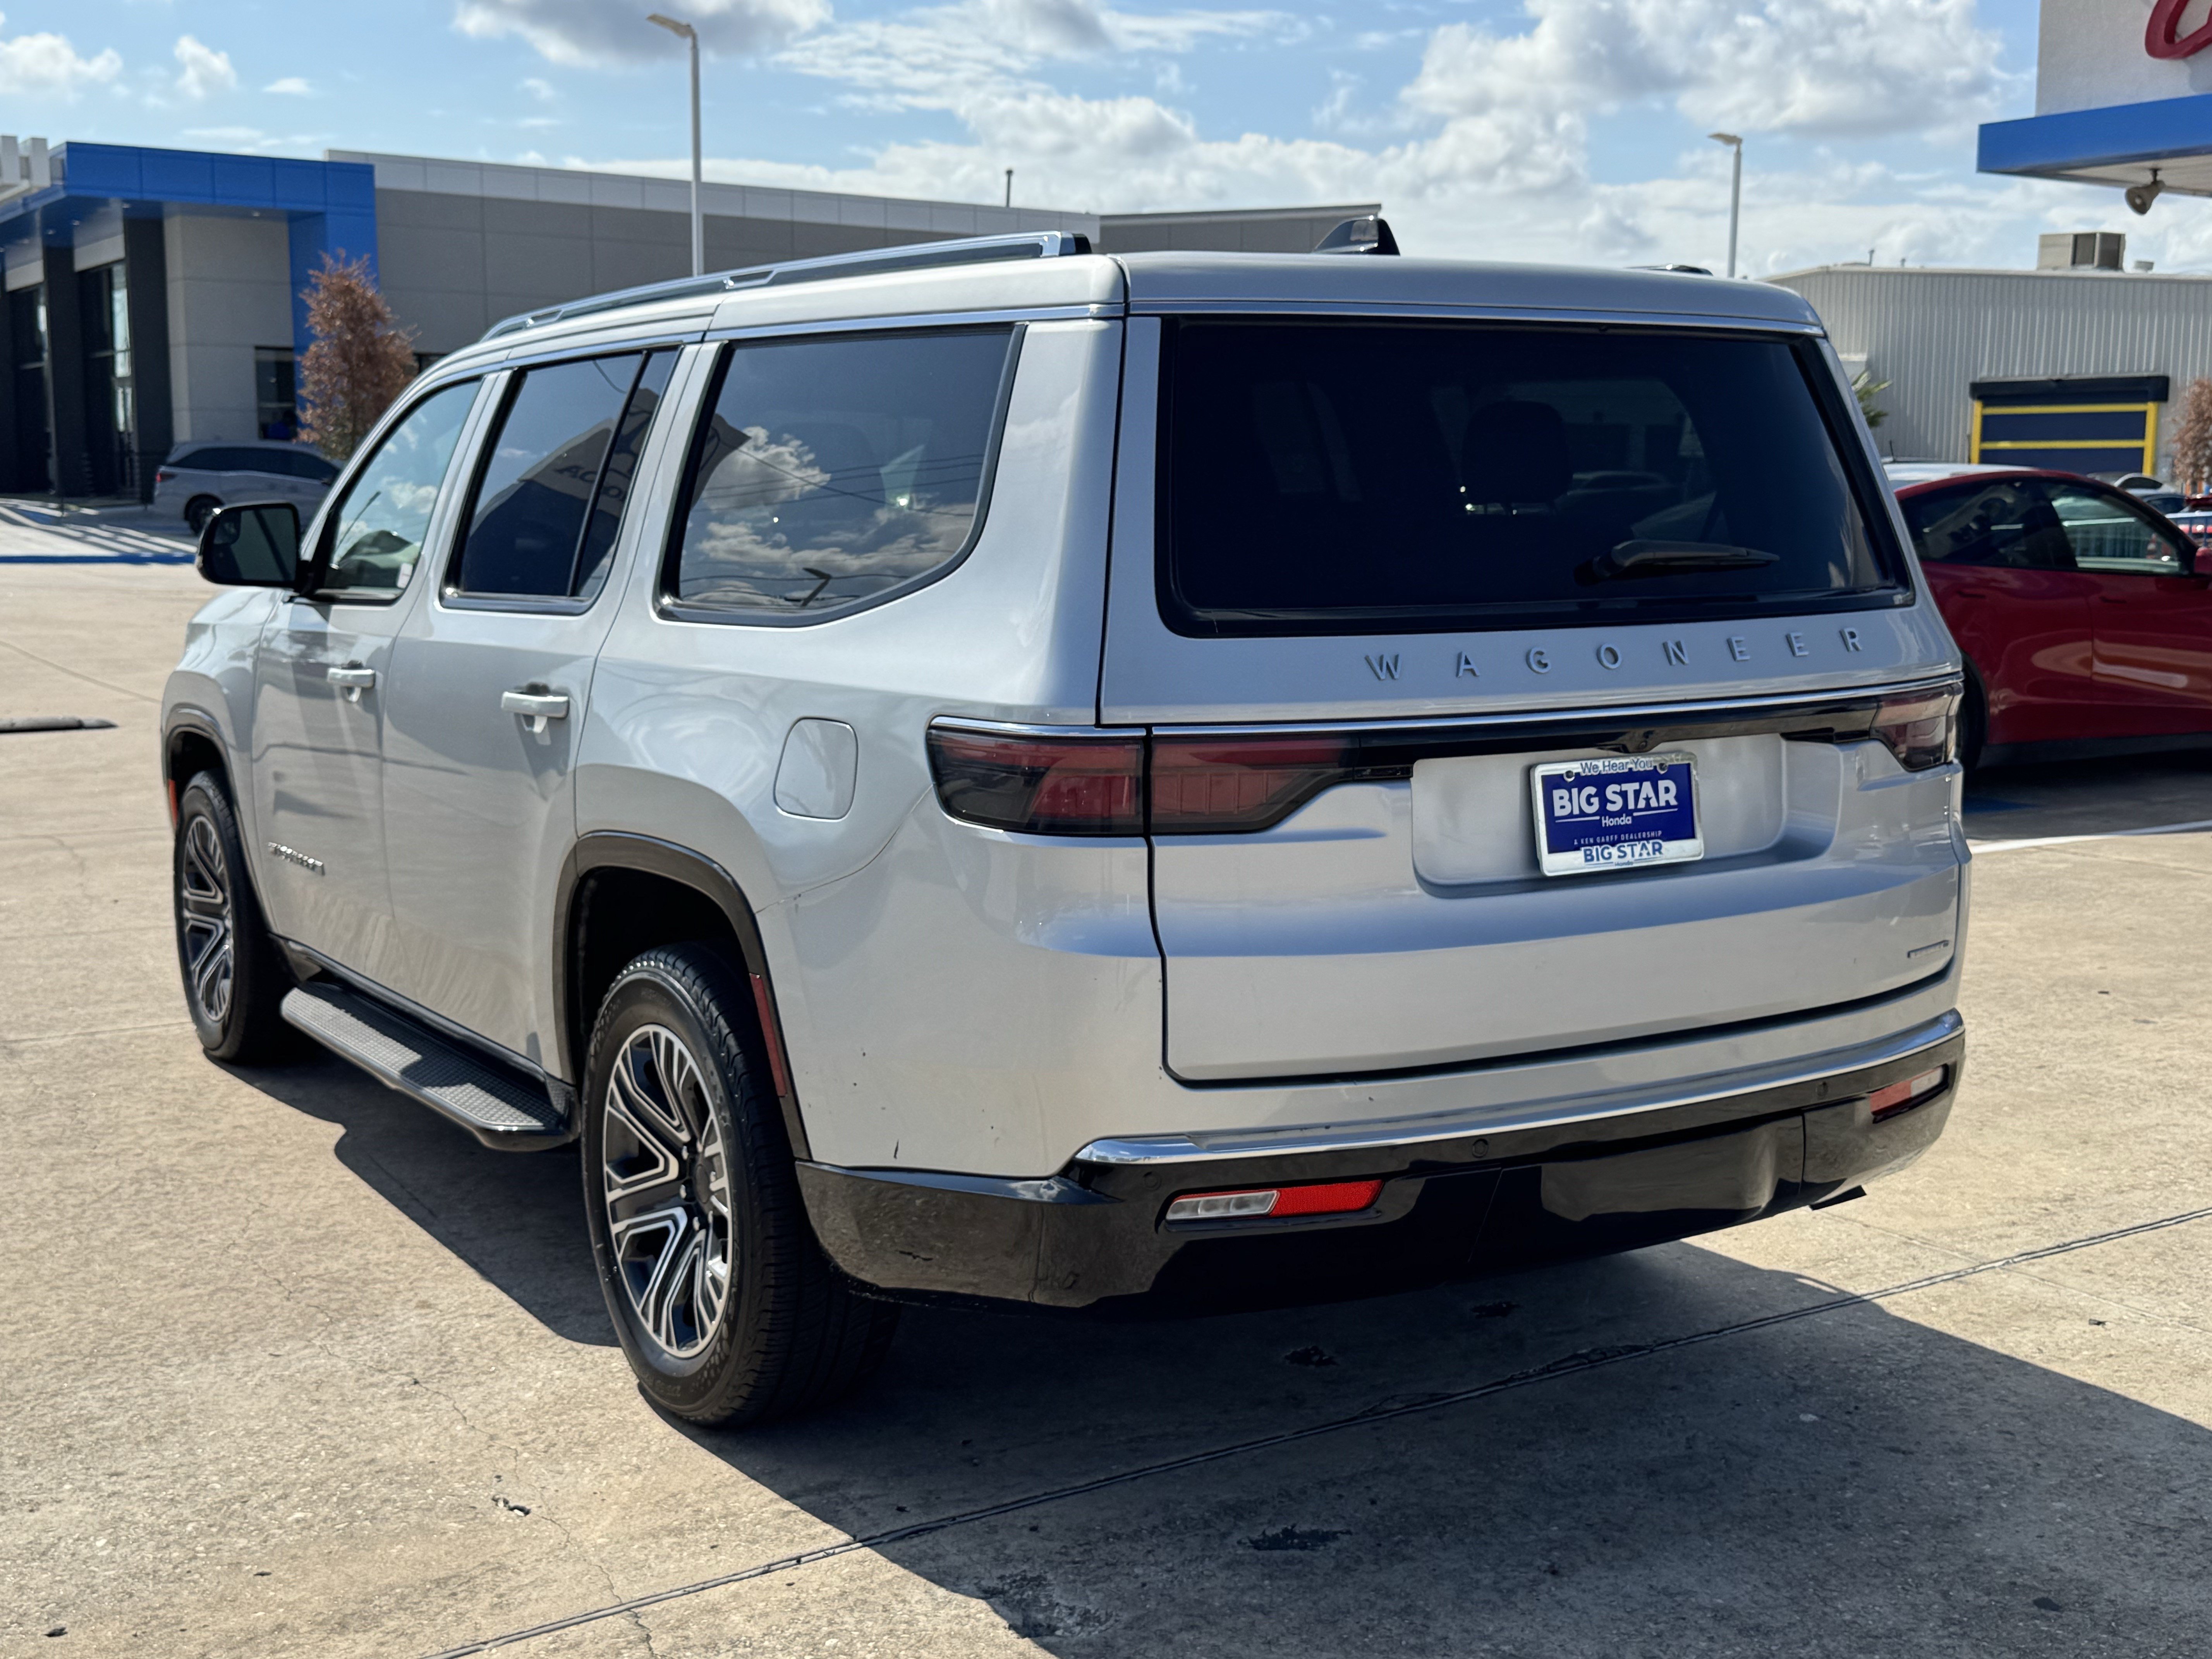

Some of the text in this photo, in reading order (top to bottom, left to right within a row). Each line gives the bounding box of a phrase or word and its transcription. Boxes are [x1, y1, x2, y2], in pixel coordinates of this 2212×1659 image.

[1365, 627, 1862, 682] WAGONEER
[1580, 758, 1653, 773] We Hear You
[1553, 780, 1678, 817] BIG STAR
[1601, 813, 1632, 827] Honda
[1596, 835, 1618, 843] GARFF
[1621, 830, 1662, 840] DEALERSHIP
[1583, 842, 1663, 862] BIG STAR
